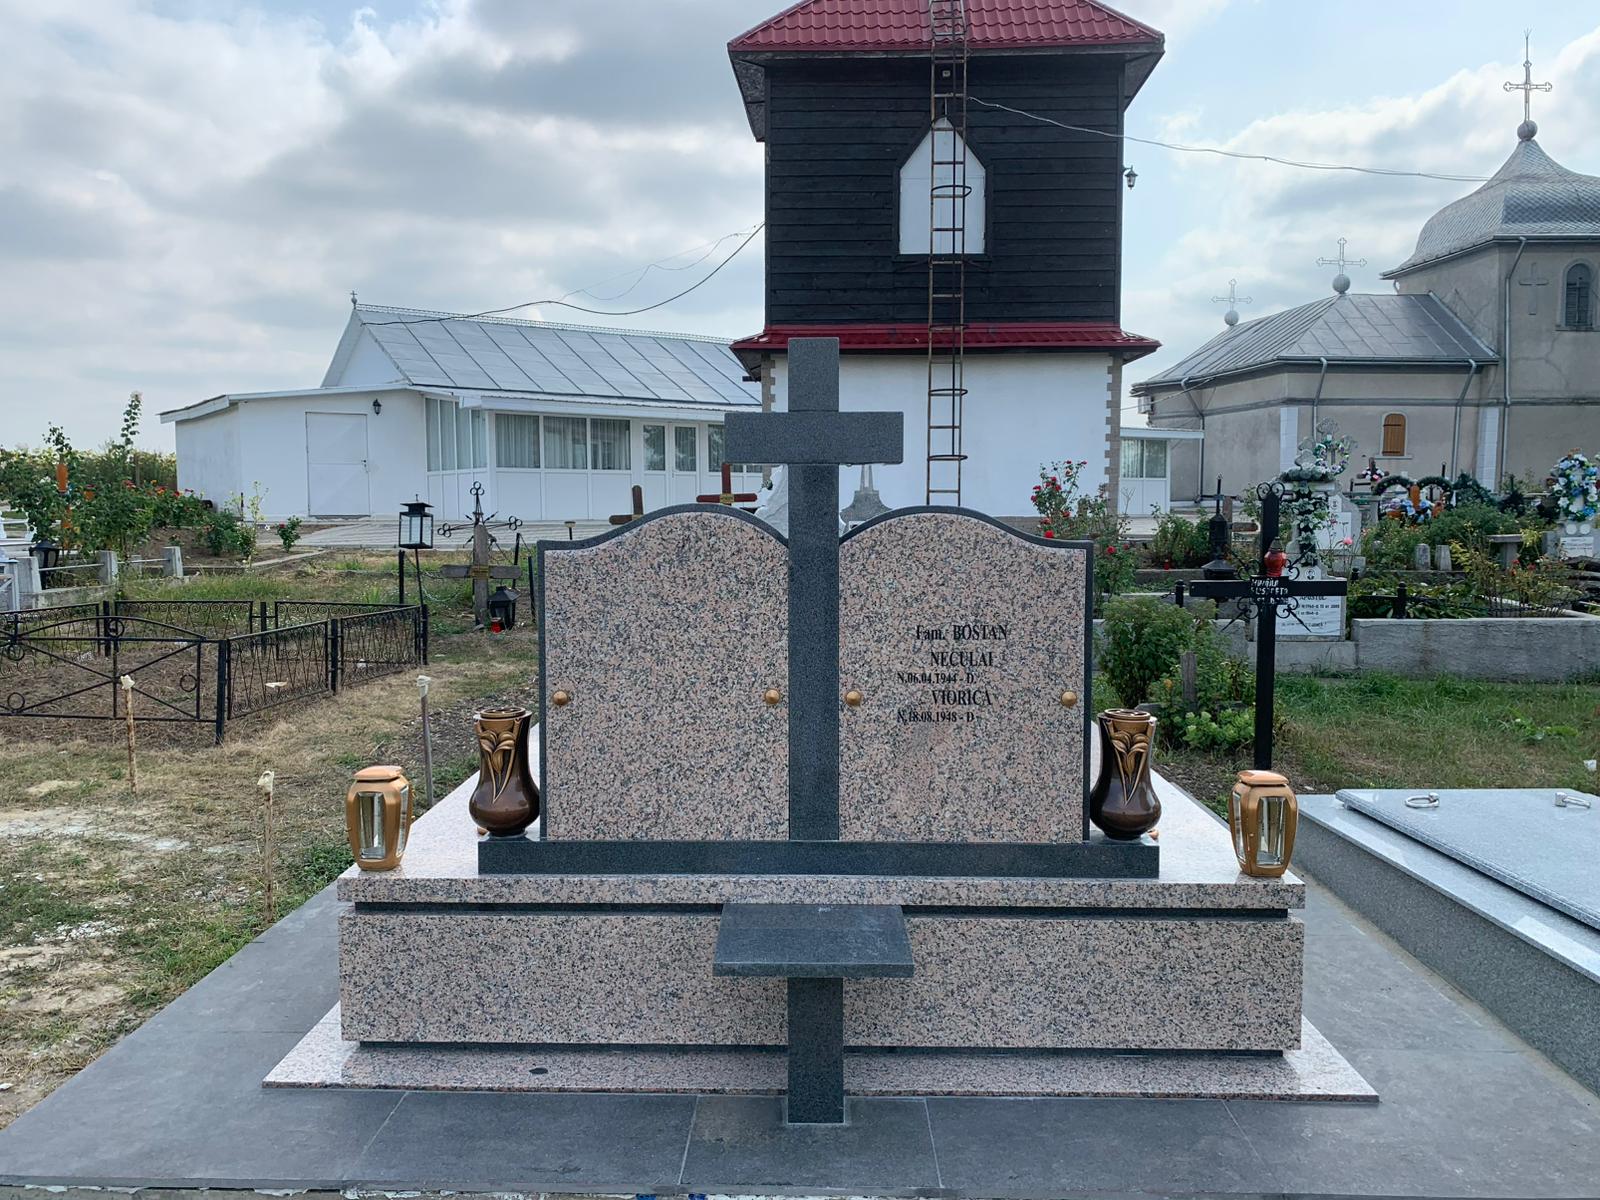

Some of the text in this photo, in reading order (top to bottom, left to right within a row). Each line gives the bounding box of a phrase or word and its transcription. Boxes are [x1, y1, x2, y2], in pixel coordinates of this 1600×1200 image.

[916, 624, 1008, 640] Fam. BOSTAN
[930, 651, 993, 667] NECULAI
[931, 689, 993, 706] VIORICA
